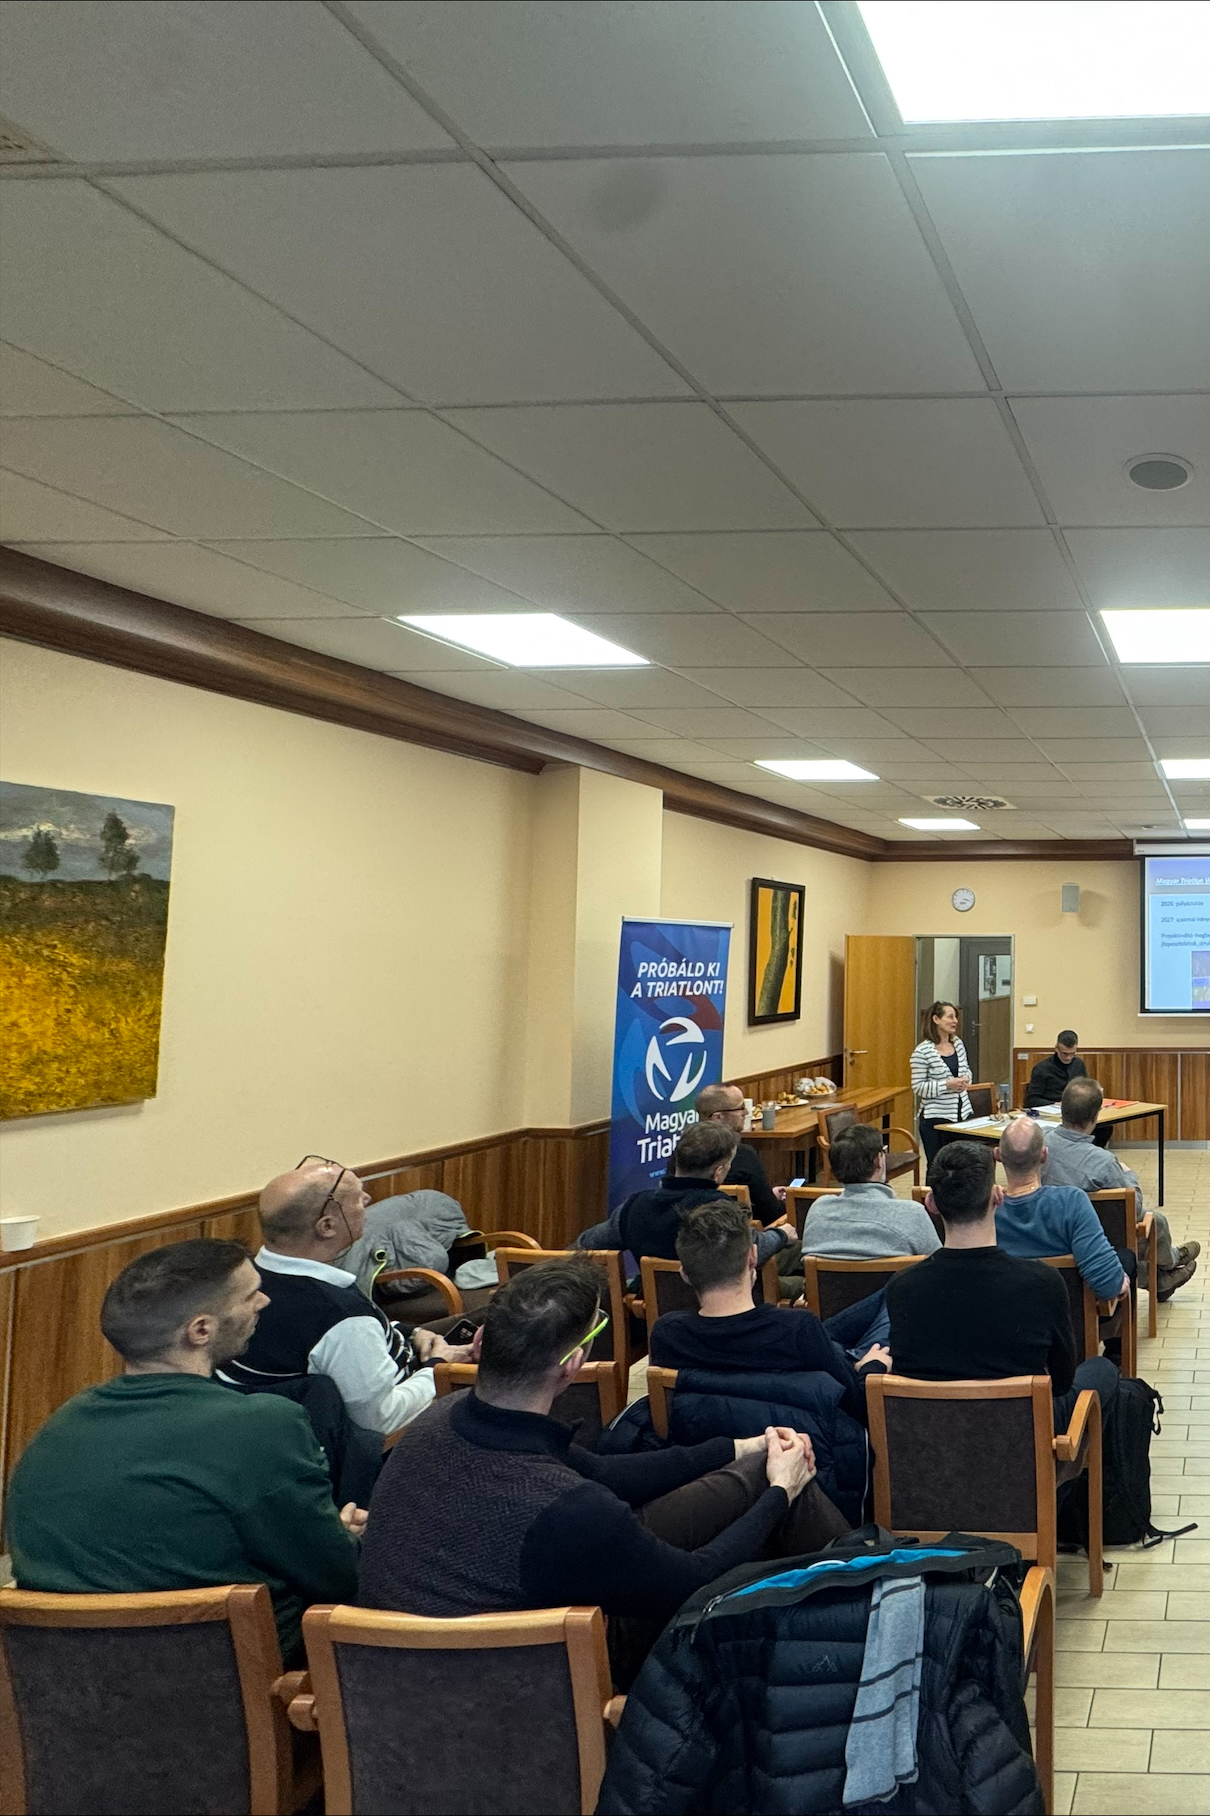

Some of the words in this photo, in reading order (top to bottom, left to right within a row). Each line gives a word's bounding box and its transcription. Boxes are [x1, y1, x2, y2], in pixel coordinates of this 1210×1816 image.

[637, 957, 705, 978] PRÓBÁLD
[706, 962, 721, 977] KI
[630, 982, 642, 998] A
[647, 980, 724, 998] TRIATLONT!
